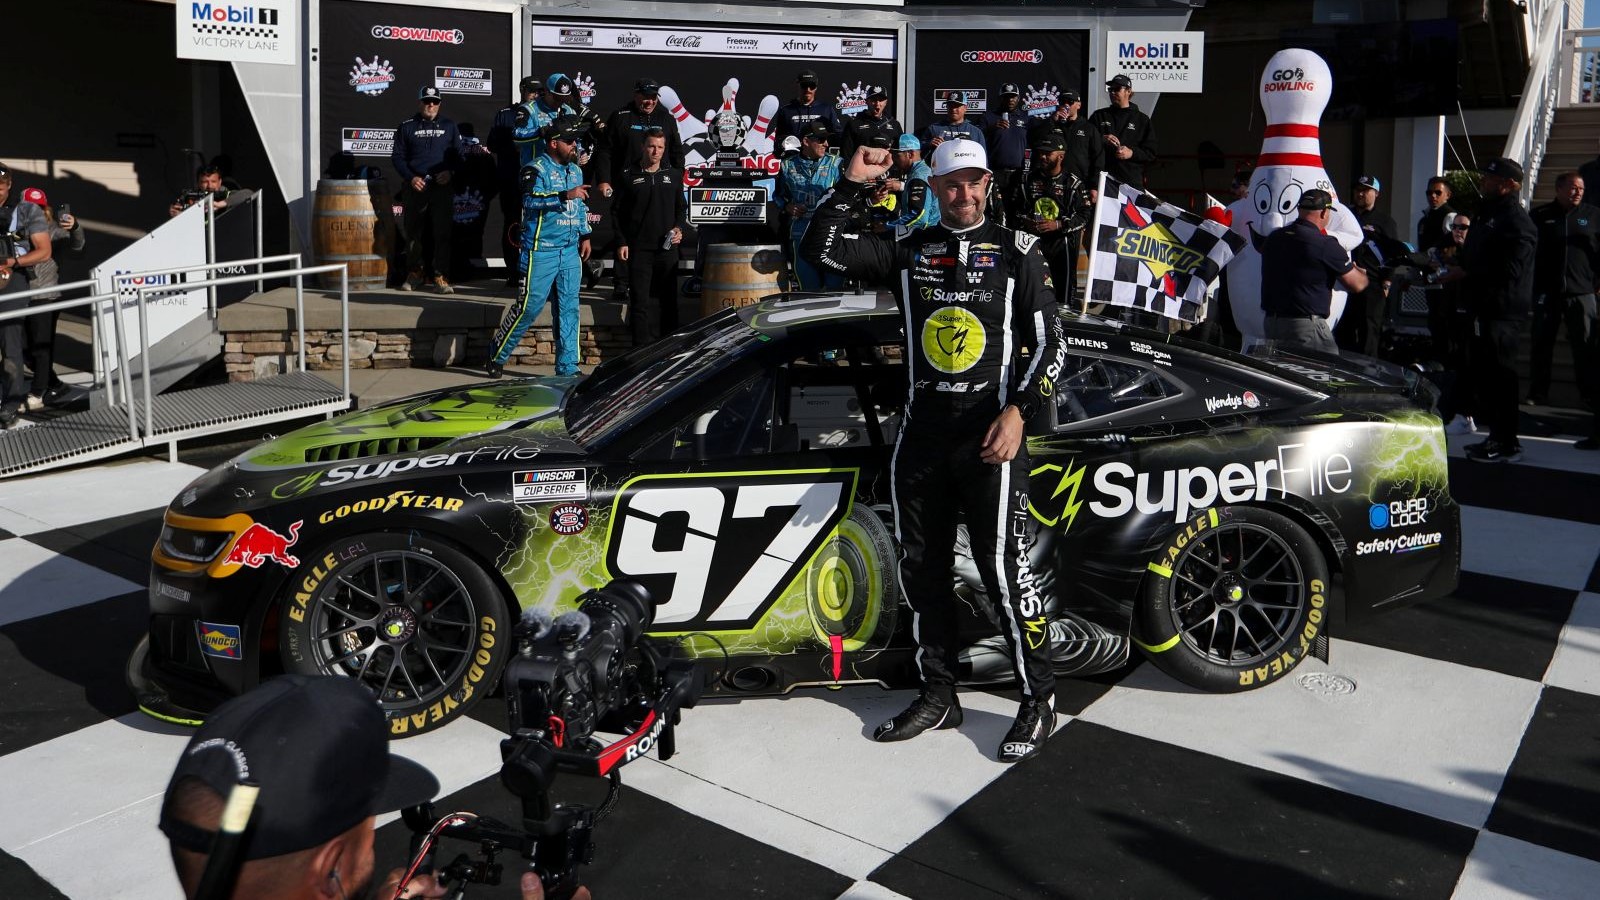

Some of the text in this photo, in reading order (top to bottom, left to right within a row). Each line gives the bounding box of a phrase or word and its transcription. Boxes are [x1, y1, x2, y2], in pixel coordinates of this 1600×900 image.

[192, 2, 275, 25] Mobil 1
[193, 37, 278, 51] VICTORY LANE
[617, 37, 641, 45] BUSCH
[727, 37, 758, 46] Freeway
[783, 40, 818, 52] xfinity
[1119, 43, 1168, 58] Mobil
[454, 70, 483, 79] NASCAR
[1119, 73, 1160, 81] ICTORY
[1272, 70, 1293, 81] GO
[459, 81, 484, 89] SERIES
[1265, 81, 1314, 92] BOWLING
[362, 131, 395, 139] NASCAR
[351, 142, 394, 150] CUP SERIES
[715, 191, 756, 201] NASCAR
[701, 207, 756, 216] CUP SERIES
[1120, 232, 1198, 269] SUNOCO
[163, 298, 188, 306] LANE
[933, 289, 990, 303] SuperFile
[1065, 336, 1109, 349] EMENS
[1205, 393, 1242, 412] Wendy's
[320, 446, 542, 487] SuperFile
[536, 471, 576, 482] NASCAR
[1089, 443, 1352, 524] SuperFile
[523, 484, 577, 496] CUP SERIES
[319, 490, 464, 525] GOODYEAR
[554, 506, 582, 517] NASCAR
[1390, 498, 1427, 515] QUAD
[1390, 511, 1427, 528] LOCK
[554, 521, 584, 533] SALUTES
[1161, 515, 1208, 570] EAGLE
[1356, 532, 1442, 556] SafetyCulture
[617, 482, 843, 625] 97
[1014, 493, 1043, 618] SuperFile
[289, 551, 339, 623] EAGLE
[1239, 579, 1325, 686] GOODYEAR
[391, 615, 498, 734] GOODYEAR
[625, 711, 666, 761] RONIN
